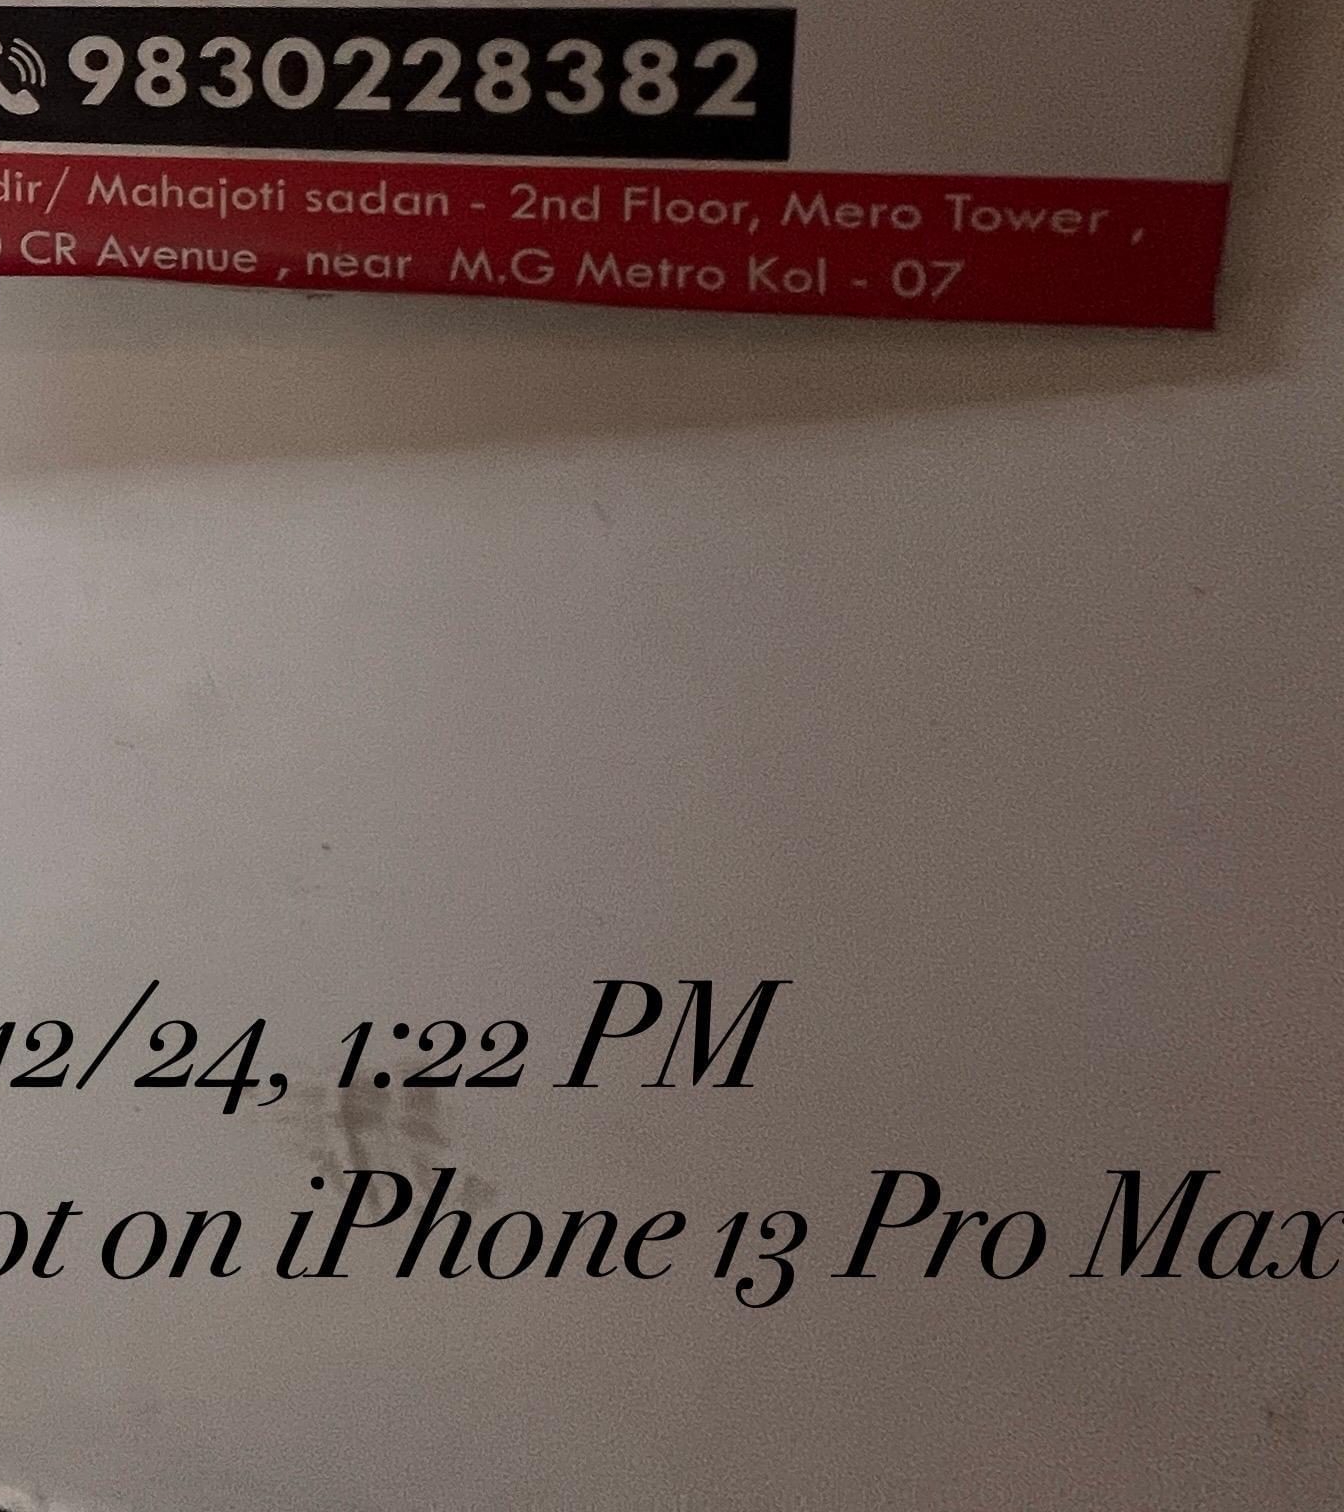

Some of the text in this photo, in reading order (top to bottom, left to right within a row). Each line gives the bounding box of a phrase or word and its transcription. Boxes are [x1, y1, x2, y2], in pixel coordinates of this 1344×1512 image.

[67, 35, 761, 118] 9830228382
[87, 174, 287, 220] Mahajoti
[305, 179, 449, 217] sadan
[511, 182, 601, 224] 2nd
[623, 186, 761, 235] Floor,
[780, 191, 922, 232] Mero
[945, 193, 1111, 235] Tower
[19, 230, 77, 266] CR
[96, 234, 259, 275] Avenue
[306, 248, 413, 281] near
[449, 247, 554, 286] M.G
[576, 251, 728, 292] Metro
[747, 256, 827, 296] Kol
[891, 259, 965, 302] 07
